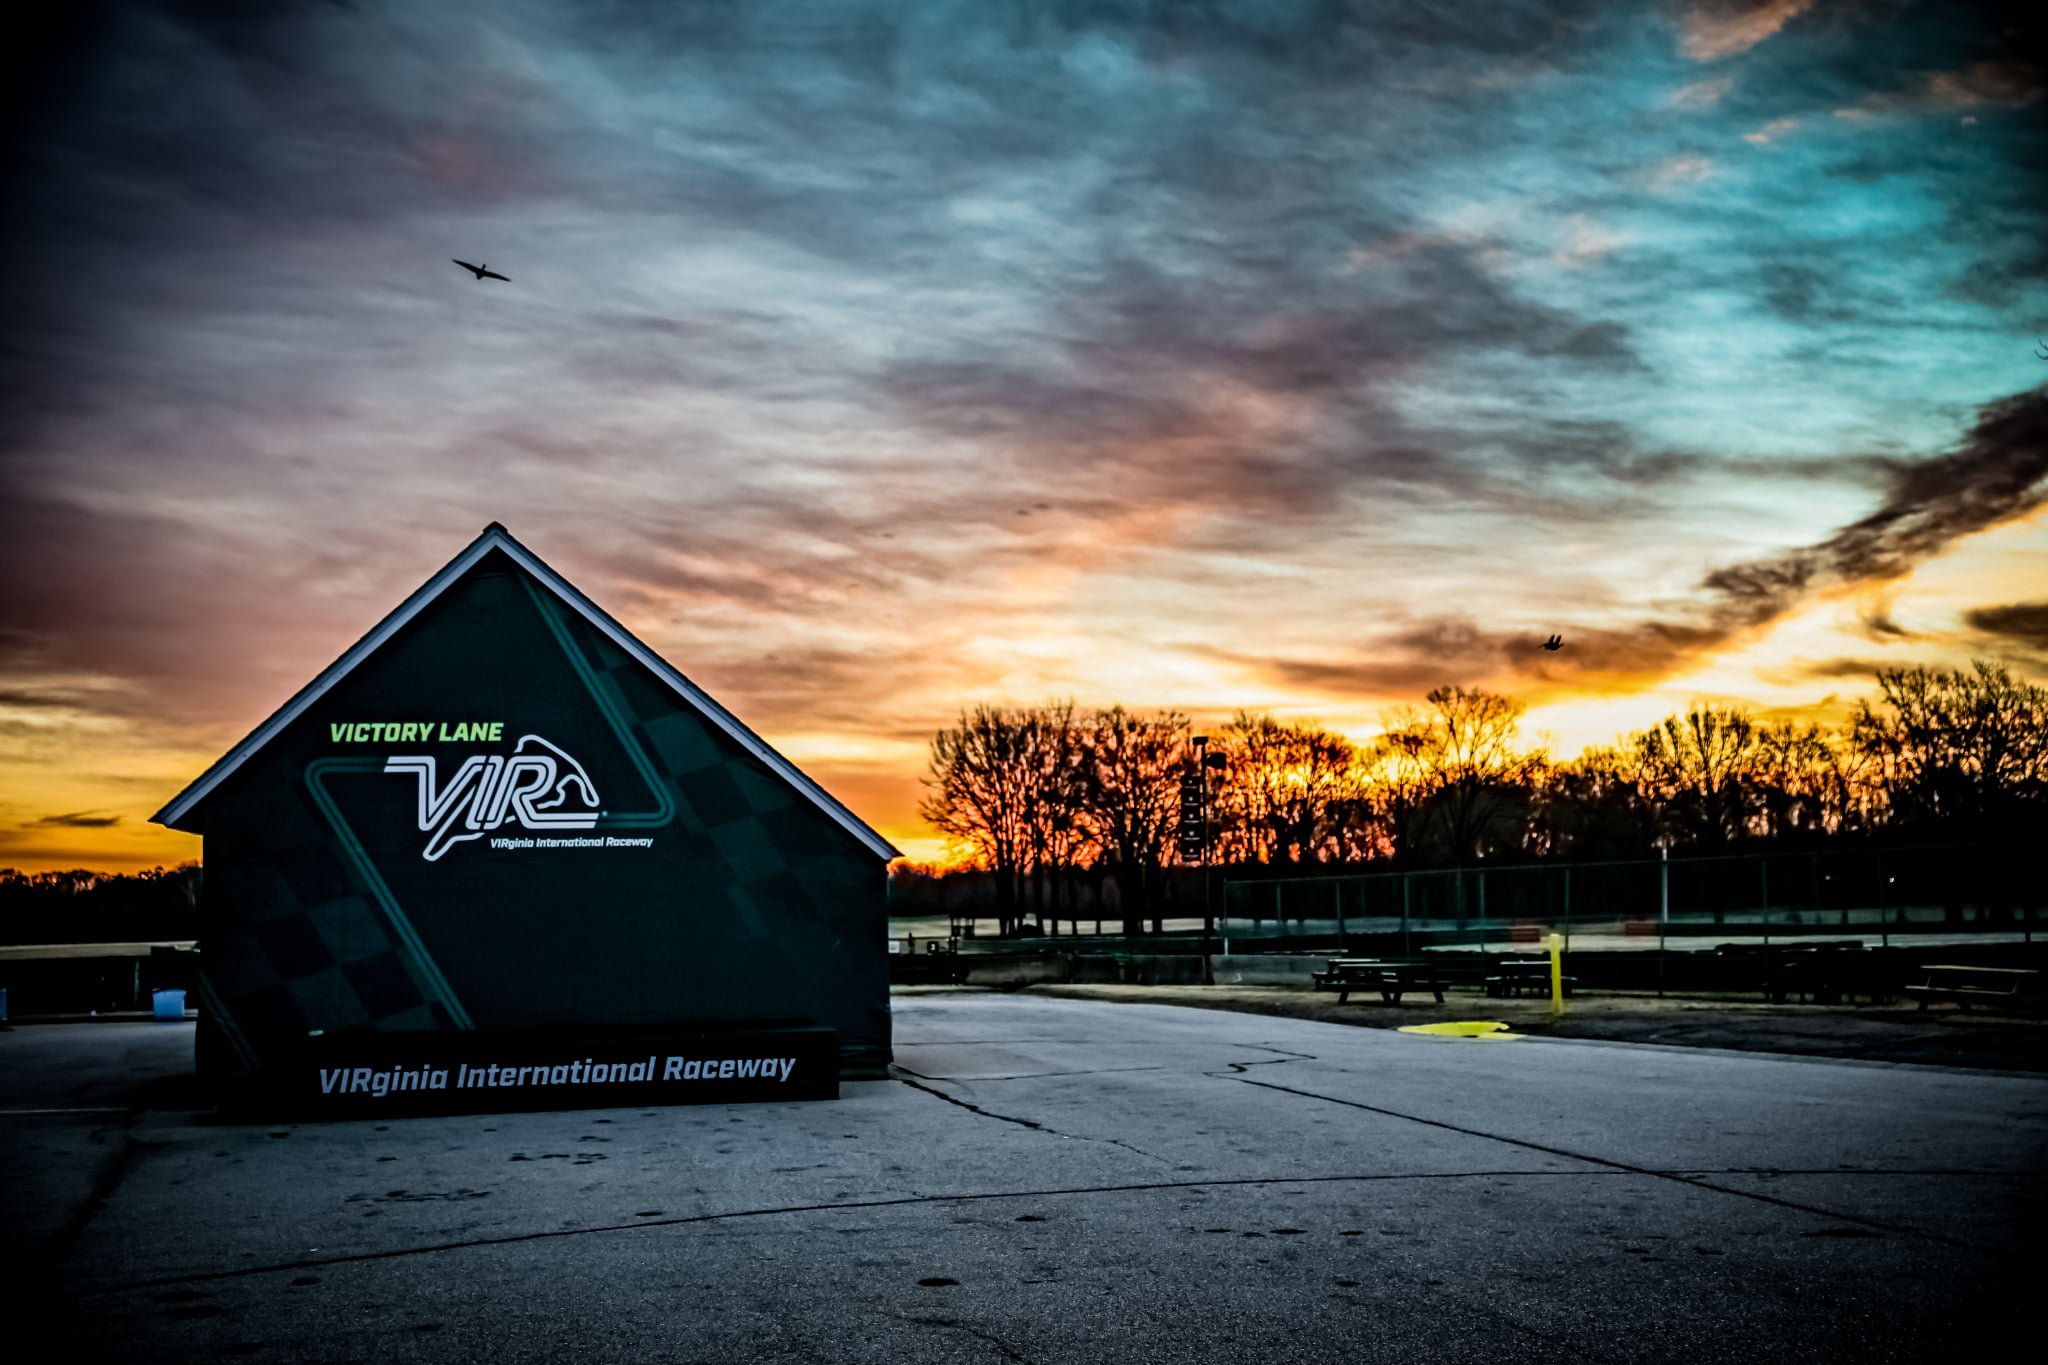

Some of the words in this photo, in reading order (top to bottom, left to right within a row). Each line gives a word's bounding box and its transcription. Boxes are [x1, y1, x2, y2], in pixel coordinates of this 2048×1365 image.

[330, 722, 436, 743] VICTORY
[439, 722, 504, 741] LANE
[490, 837, 535, 850] VIRginia
[536, 836, 605, 848] International
[606, 836, 654, 849] Raceway
[319, 1064, 449, 1098] VIRginia
[457, 1056, 657, 1088] International
[663, 1055, 798, 1083] Raceway
